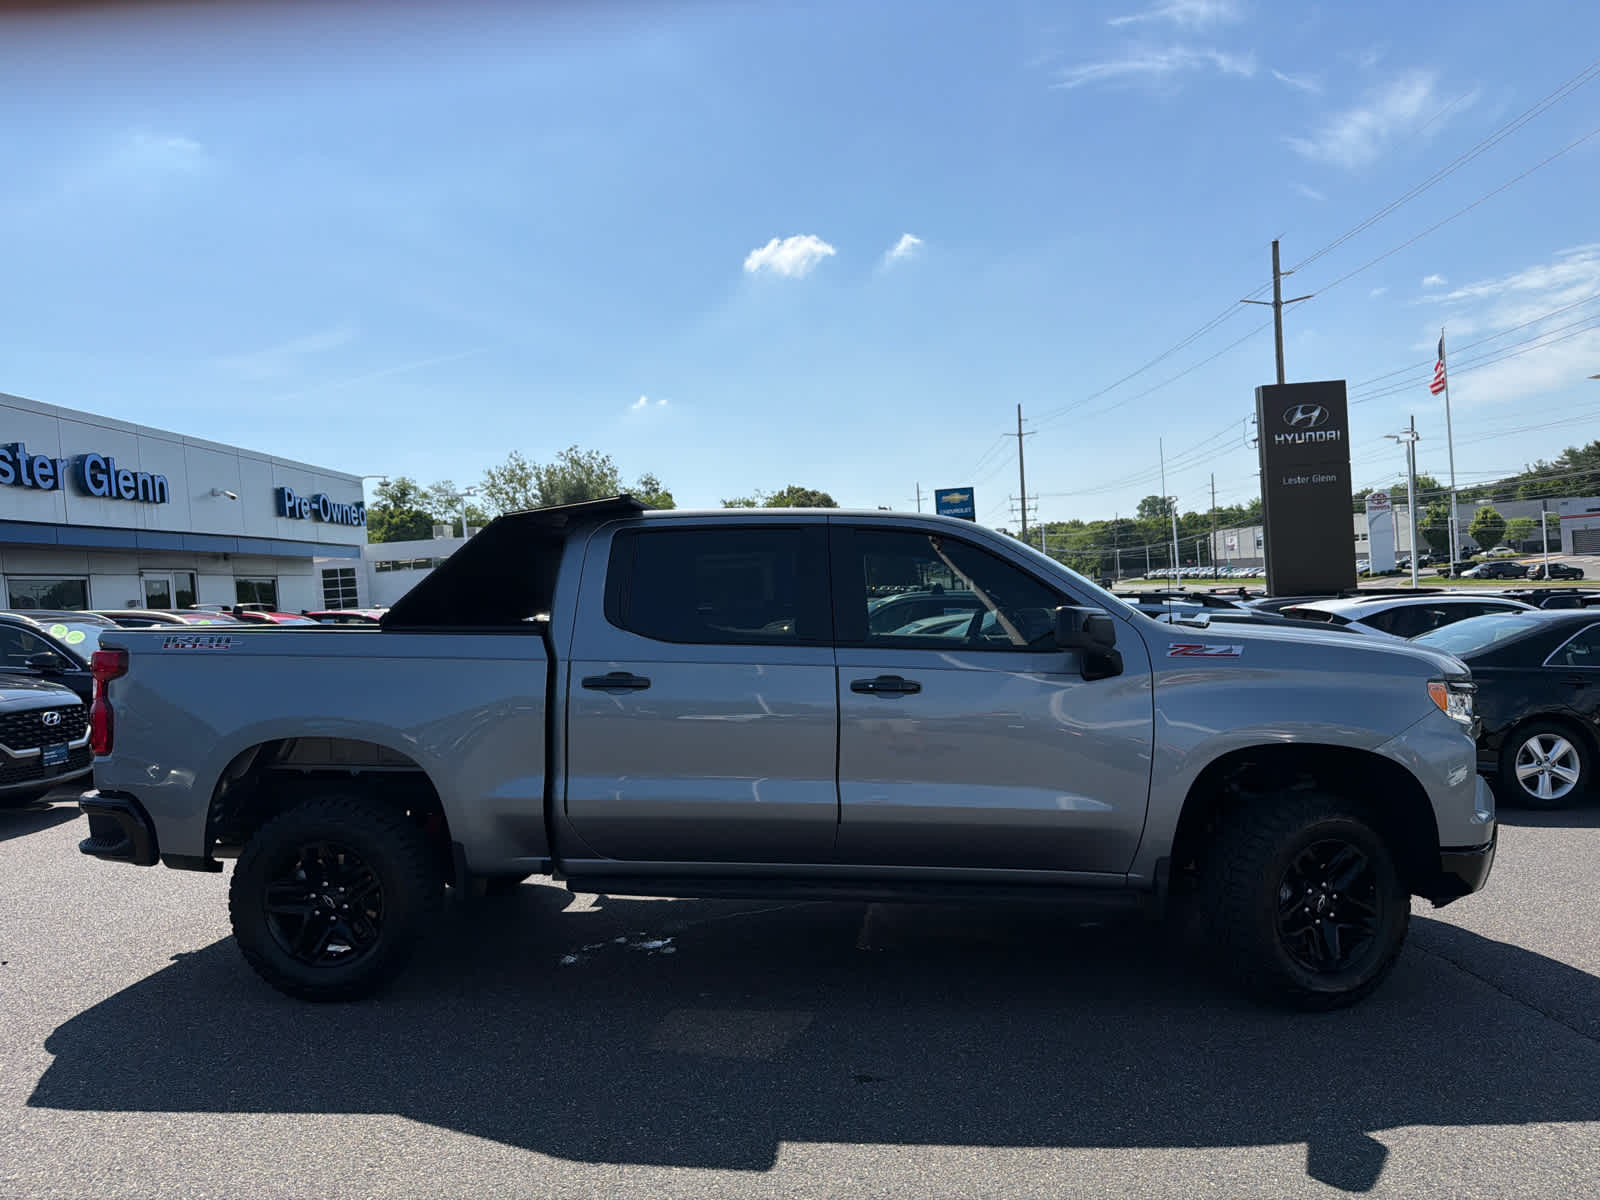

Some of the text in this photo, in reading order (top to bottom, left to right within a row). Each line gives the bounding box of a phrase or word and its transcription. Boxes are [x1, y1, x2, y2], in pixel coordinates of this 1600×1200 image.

[1274, 430, 1341, 445] HYUNDAI
[83, 452, 170, 504] Glenn
[1282, 473, 1338, 486] Lester Glenn
[283, 486, 368, 527] Pre-Owned
